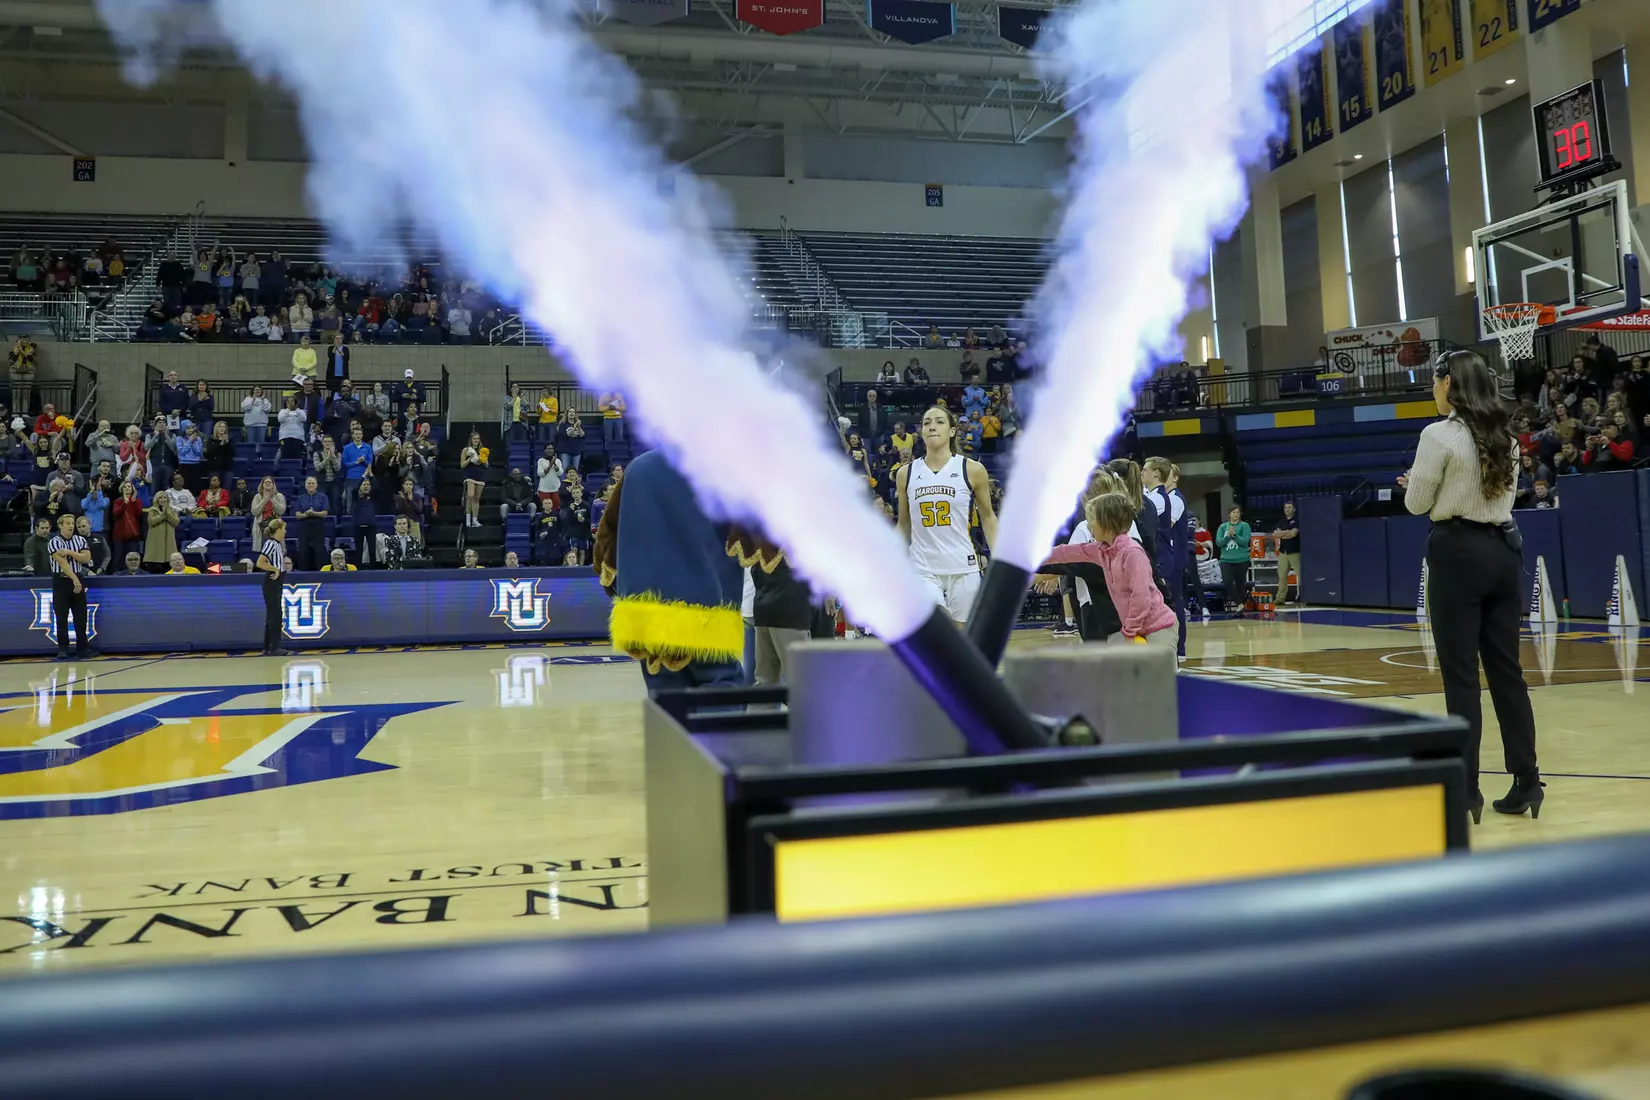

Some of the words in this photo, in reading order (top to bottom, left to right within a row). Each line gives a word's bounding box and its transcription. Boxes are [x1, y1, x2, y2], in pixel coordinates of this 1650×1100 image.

[751, 4, 767, 12] ST.
[769, 7, 808, 15] JOHN'S
[885, 14, 939, 24] VILLANOVA
[1479, 16, 1502, 47] 22
[1429, 46, 1448, 75] 21
[1382, 71, 1402, 100] 20
[1342, 95, 1359, 121] 15
[1305, 116, 1321, 141] 14
[1553, 121, 1592, 169] 30
[77, 161, 93, 170] 202
[78, 171, 90, 180] GA
[929, 198, 940, 206] GA
[1333, 334, 1365, 345] CHUCK
[1321, 380, 1340, 392] 106
[915, 486, 955, 500] MARQUETTE
[919, 501, 951, 527] 52
[494, 580, 547, 629] MU
[1416, 585, 1425, 609] RING
[1529, 587, 1540, 613] RING
[1609, 588, 1619, 616] RING
[388, 857, 646, 883] TRUST
[129, 872, 355, 899] BANK
[0, 895, 463, 953] BANK
